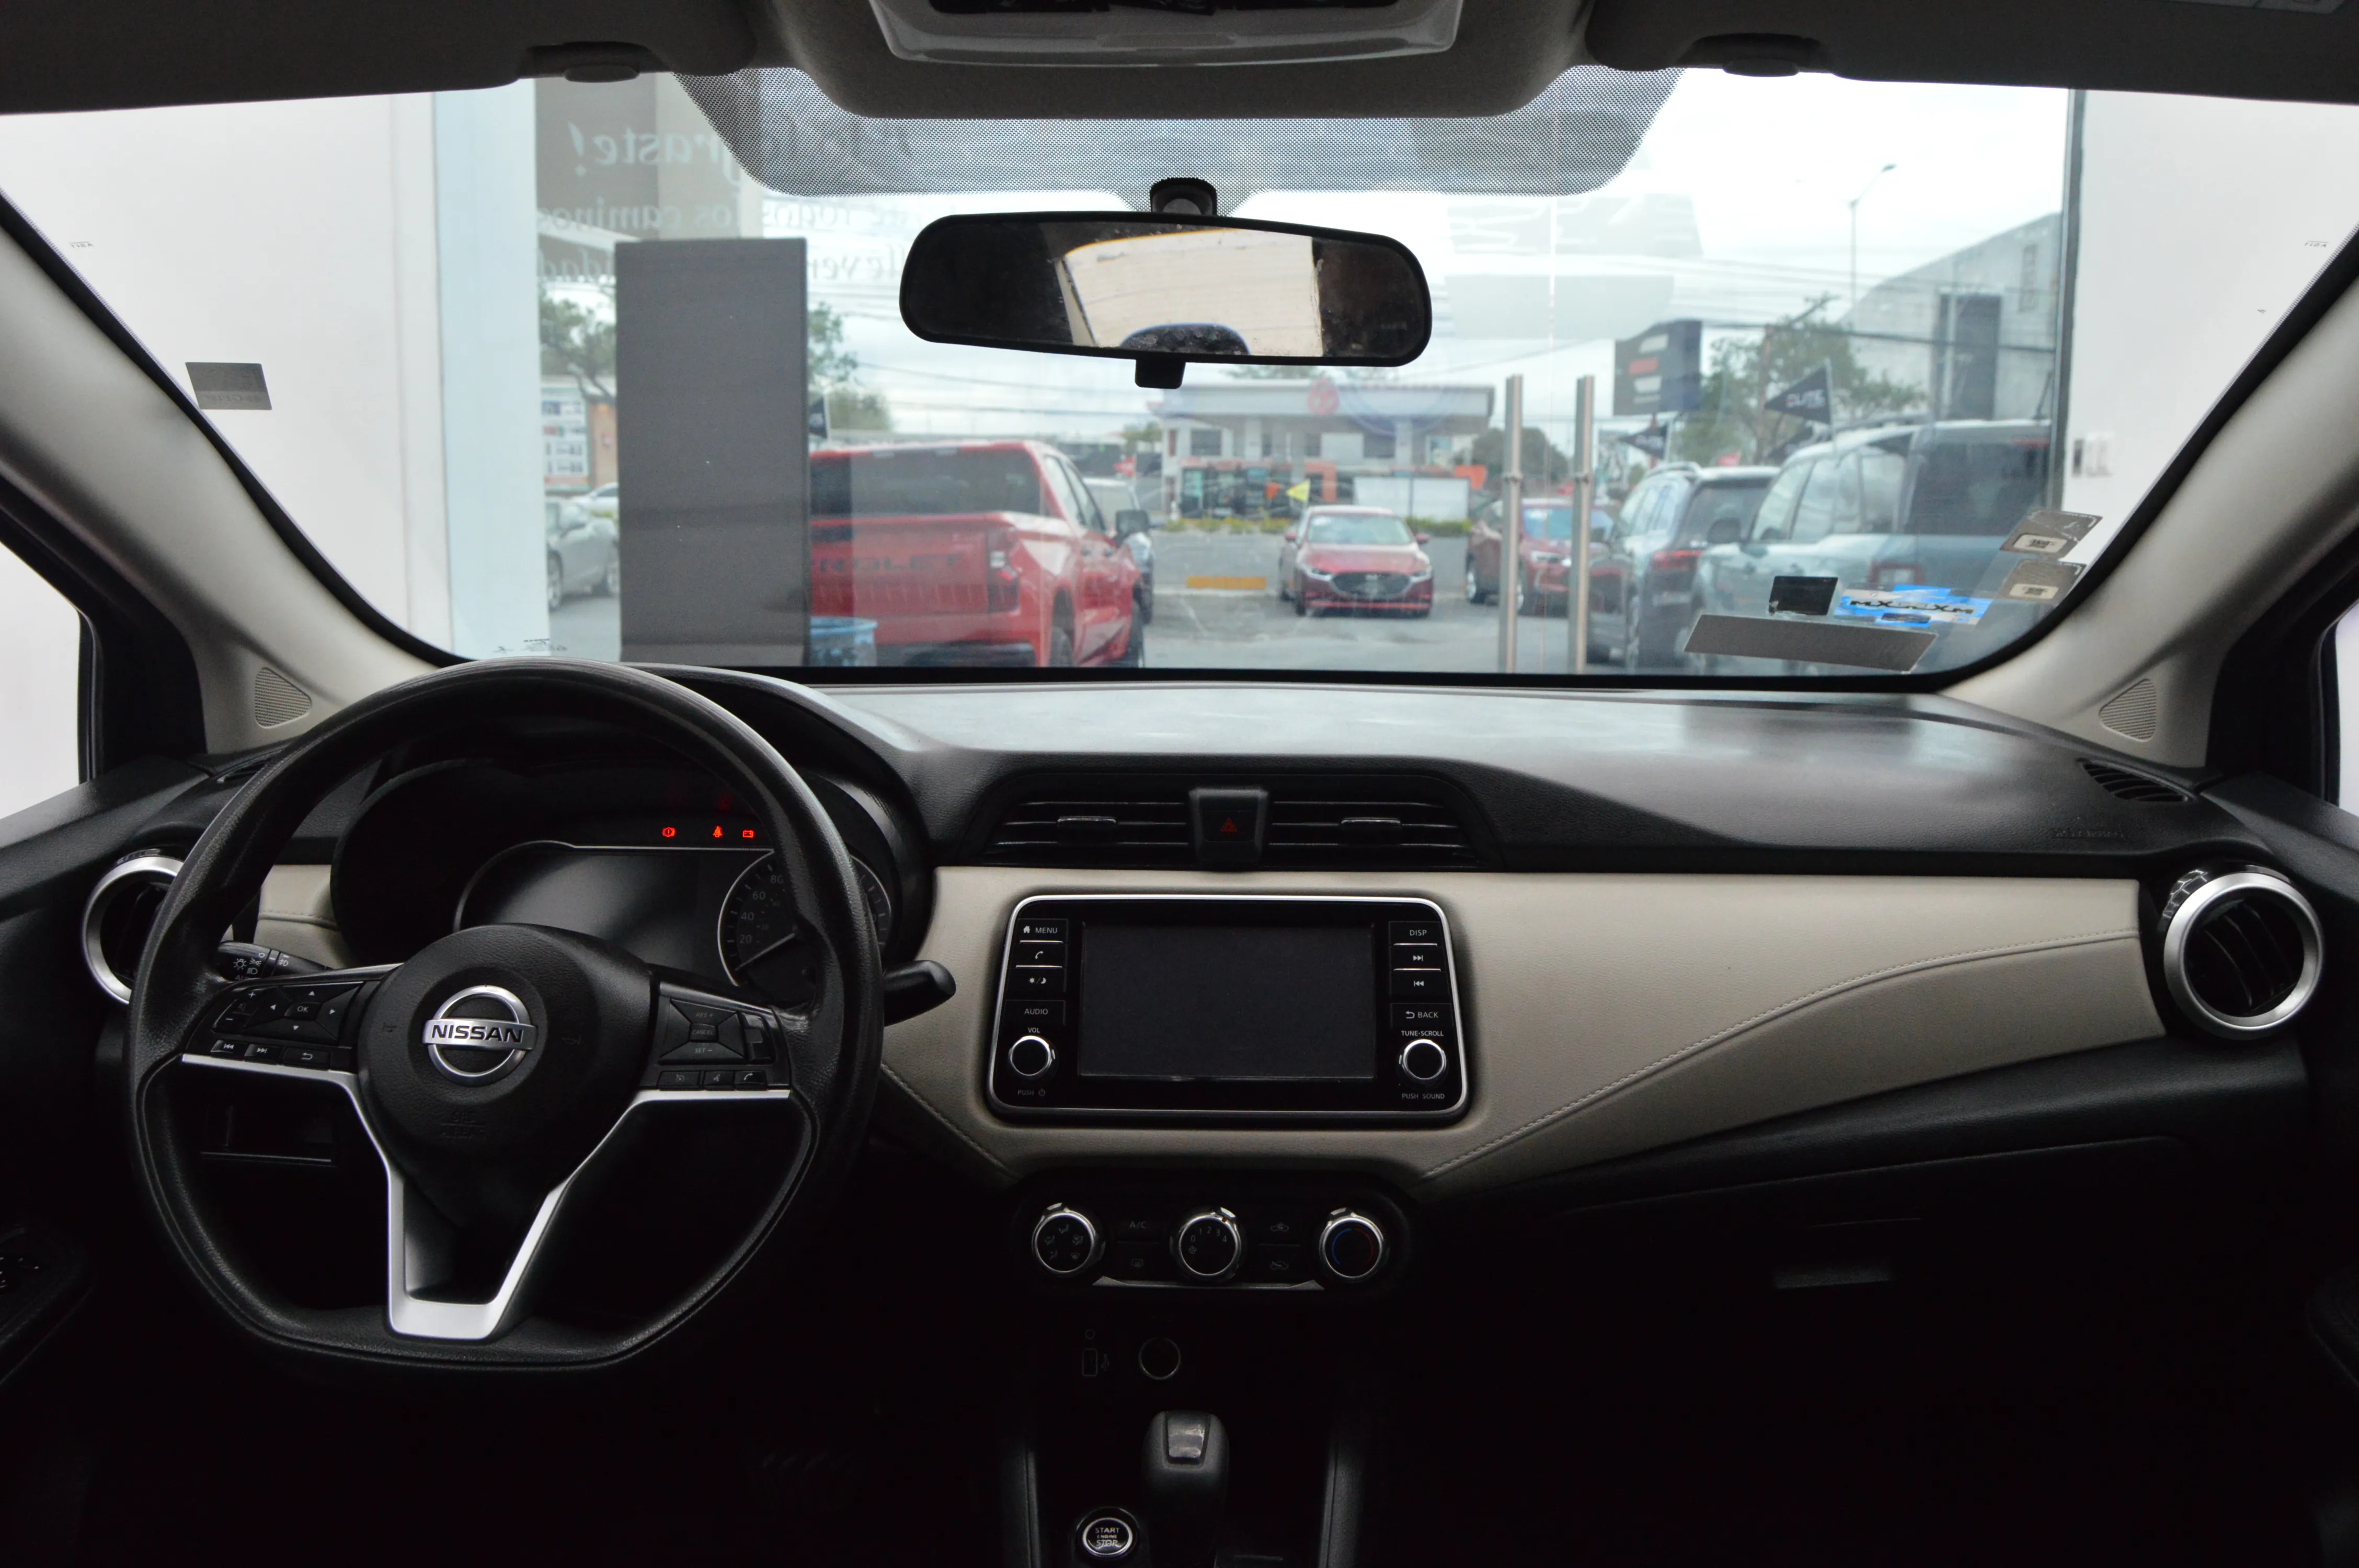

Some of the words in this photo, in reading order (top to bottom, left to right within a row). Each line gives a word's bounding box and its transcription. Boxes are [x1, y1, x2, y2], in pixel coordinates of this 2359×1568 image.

[770, 874, 784, 884] 80
[753, 891, 765, 900] 60
[741, 912, 754, 920] 40
[740, 935, 752, 943] 20
[431, 1025, 523, 1043] NISSAN
[1206, 1226, 1212, 1234] 2
[1215, 1229, 1220, 1237] 3
[1222, 1235, 1228, 1243] 4
